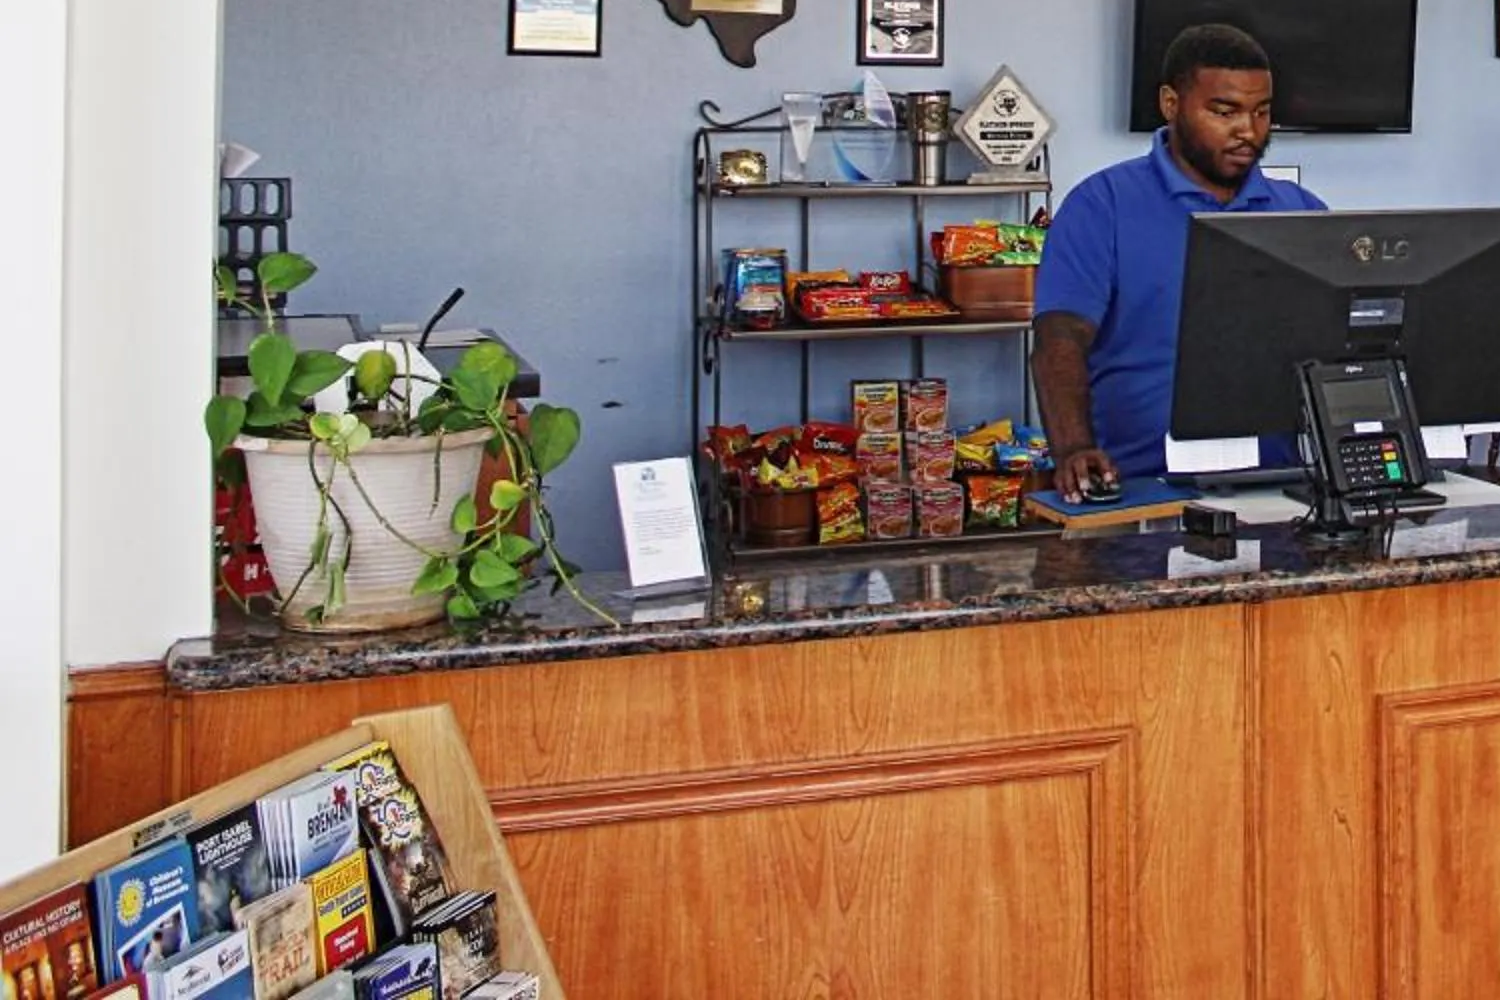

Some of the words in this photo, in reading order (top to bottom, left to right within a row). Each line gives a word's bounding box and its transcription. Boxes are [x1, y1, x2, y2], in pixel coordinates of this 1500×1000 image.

[1382, 239, 1410, 260] LG
[195, 831, 222, 853] PORT
[222, 819, 252, 843] ISABEL
[199, 829, 253, 866] LIGHTHOUSE
[3, 915, 46, 944] CULTURAL
[45, 898, 81, 921] HISTORY
